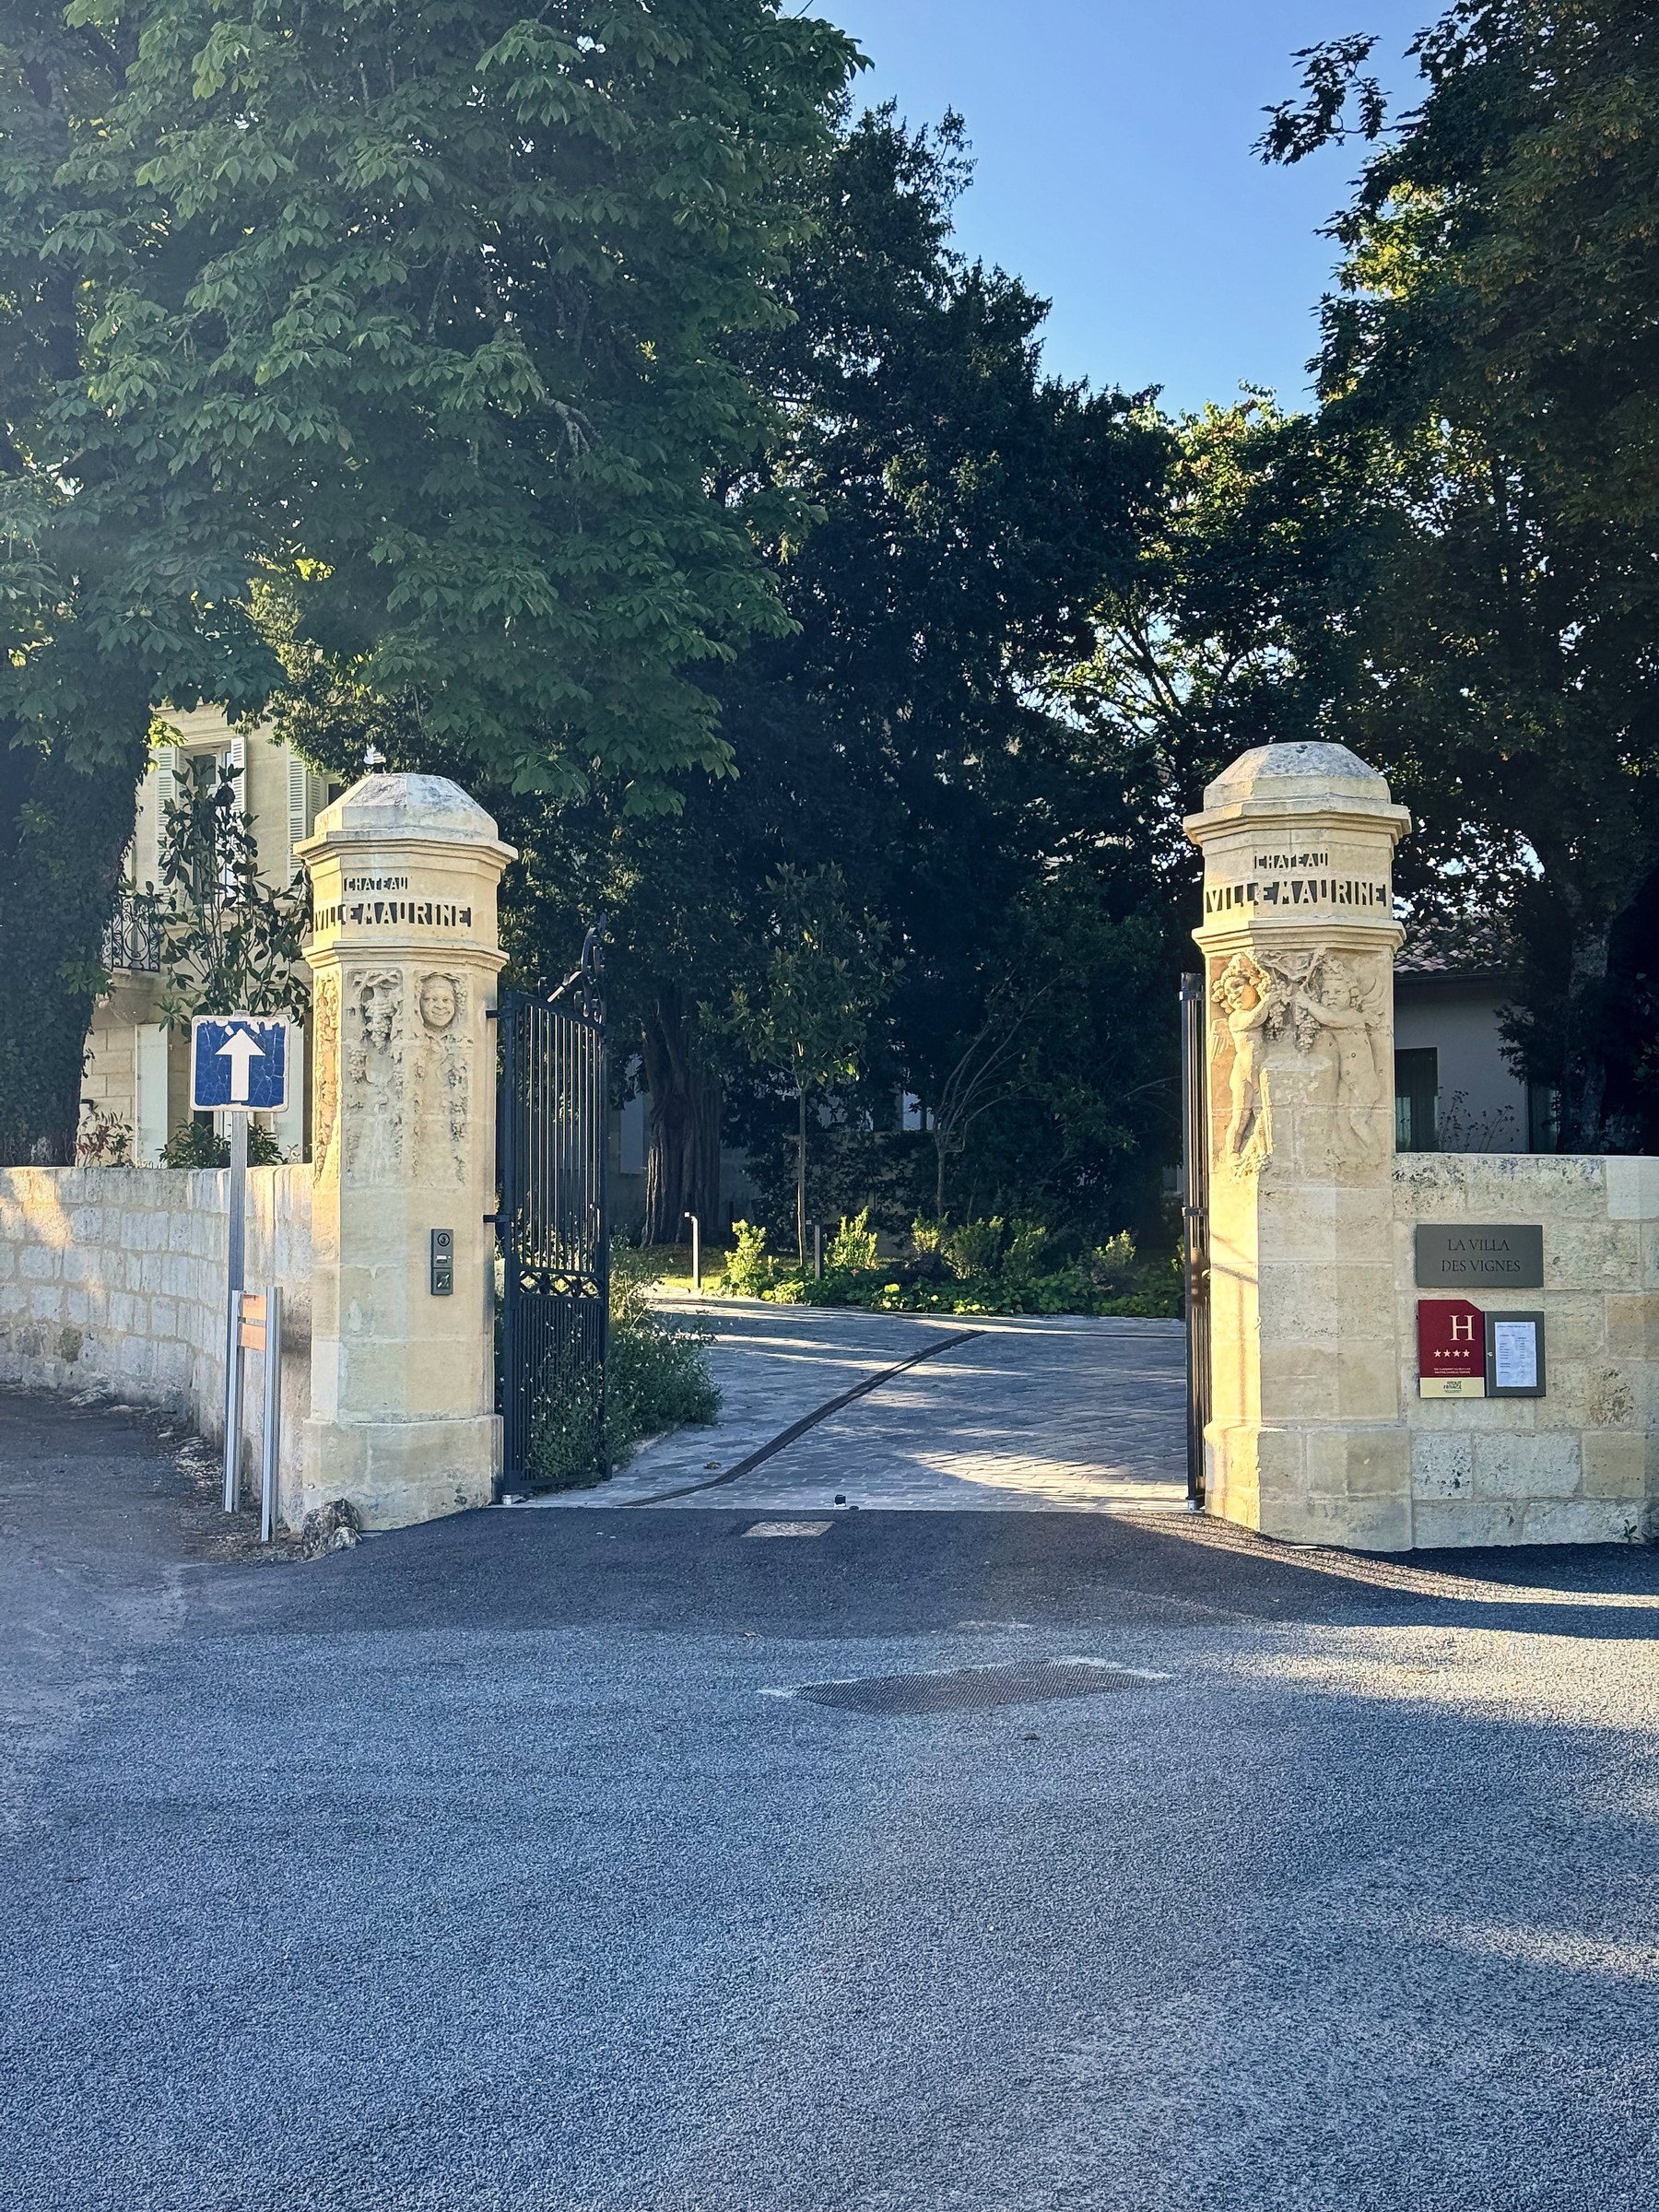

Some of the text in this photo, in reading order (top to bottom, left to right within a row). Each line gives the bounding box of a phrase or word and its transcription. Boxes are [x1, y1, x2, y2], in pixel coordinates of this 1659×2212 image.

[1254, 853, 1328, 869] CHATEAU
[344, 877, 408, 891] CHATEAU
[1448, 1239, 1510, 1251] LA VILLA
[1441, 1260, 1521, 1272] DES VIGNES
[1449, 1315, 1476, 1341] H
